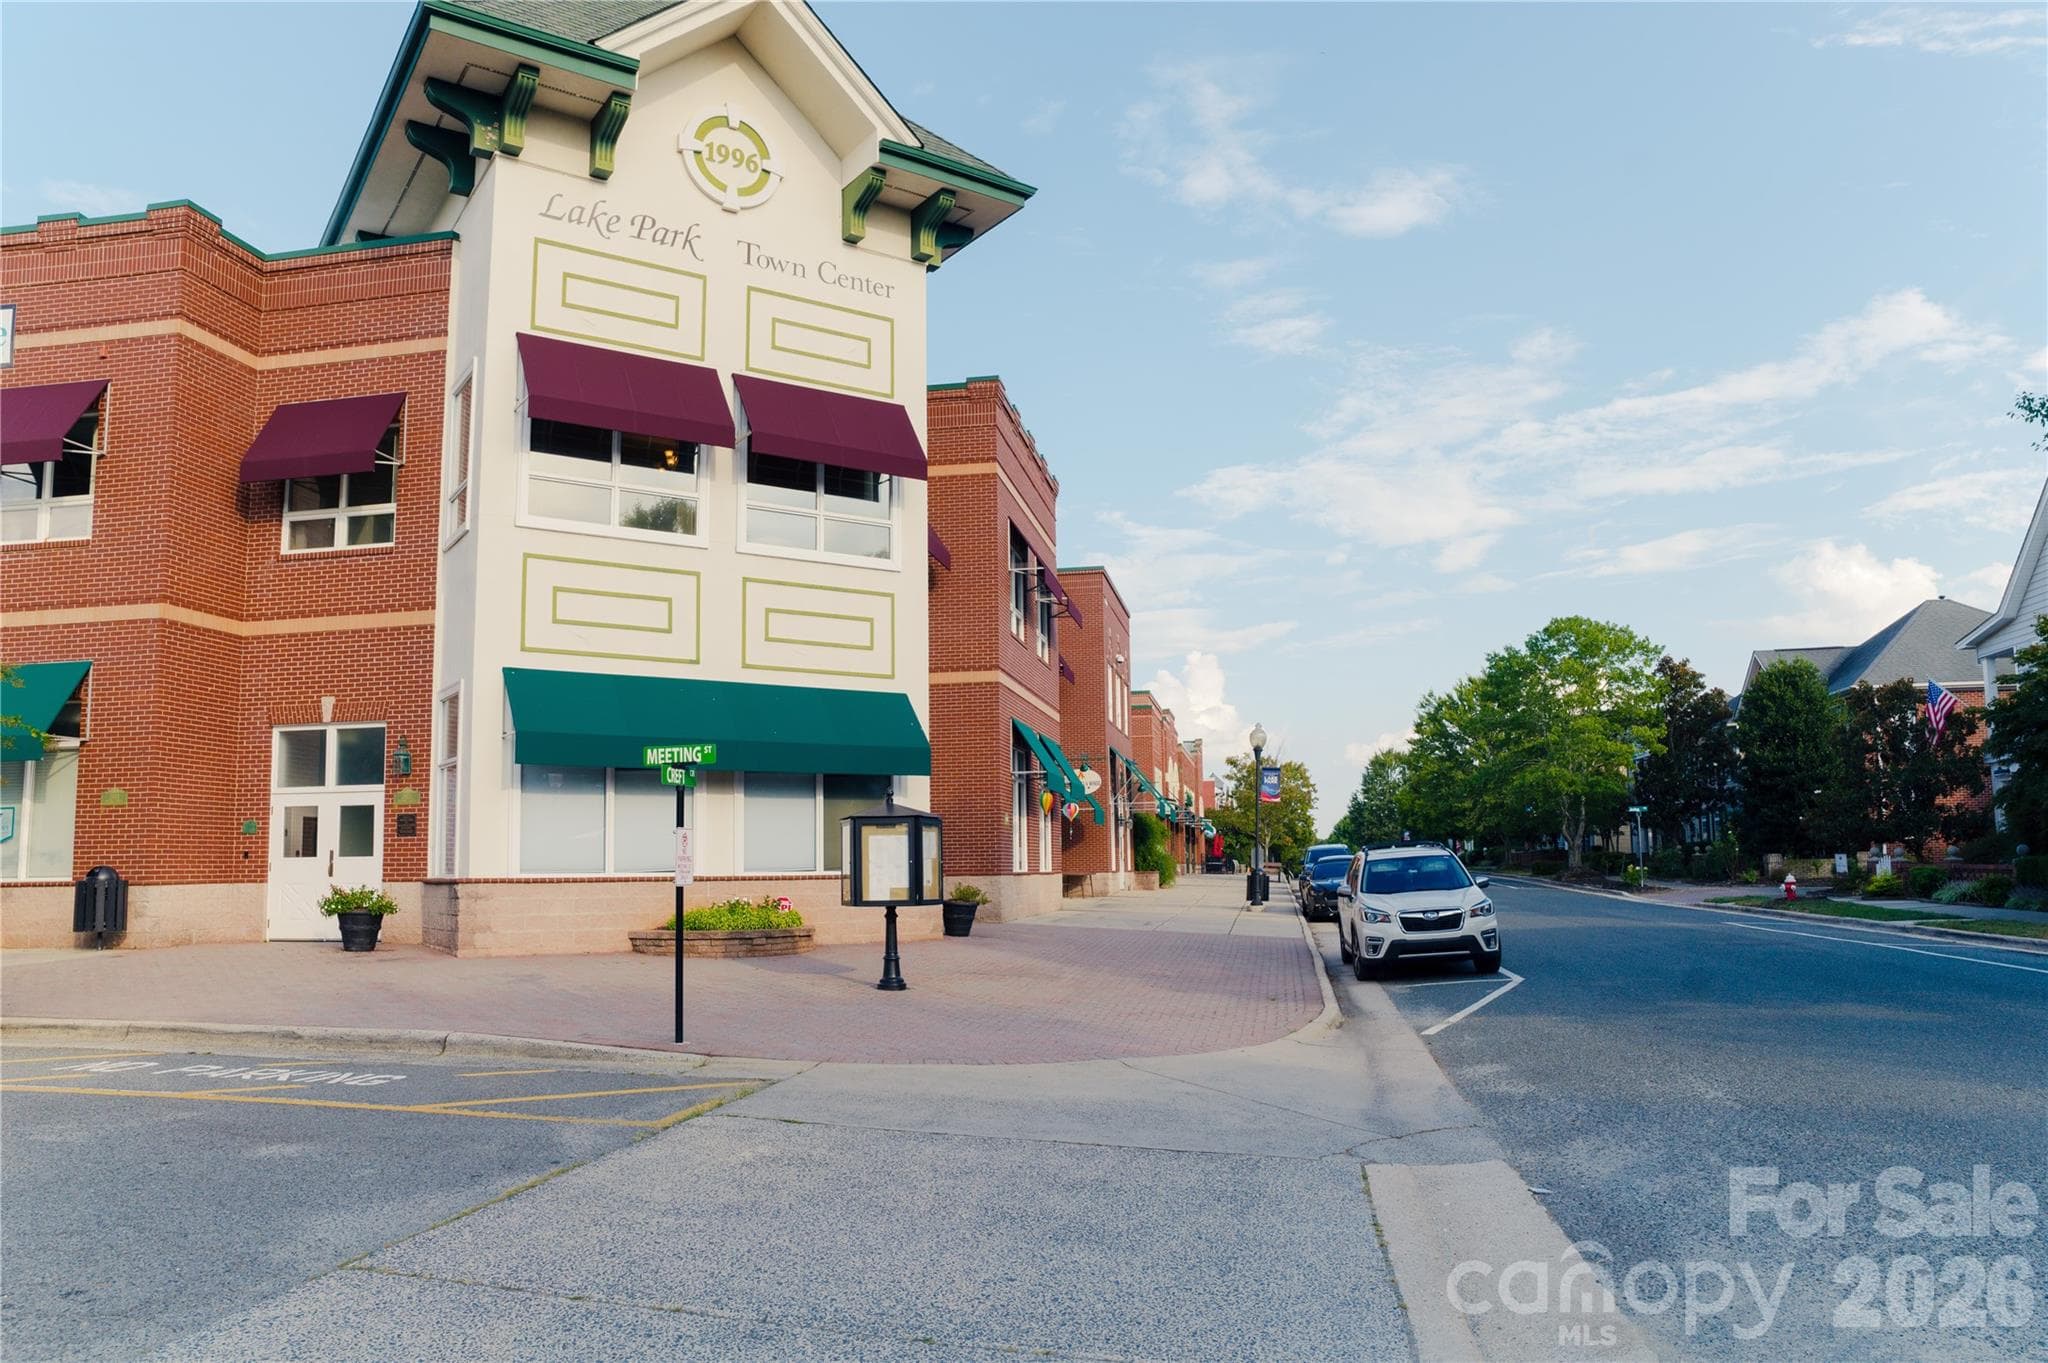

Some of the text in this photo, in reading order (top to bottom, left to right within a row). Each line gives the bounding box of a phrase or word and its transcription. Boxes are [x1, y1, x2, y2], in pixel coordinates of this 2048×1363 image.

[704, 140, 760, 174] 1996
[538, 192, 896, 299] Lake Park Town Center
[646, 745, 712, 765] MEETING ST
[50, 1061, 407, 1087] NO PARKING
